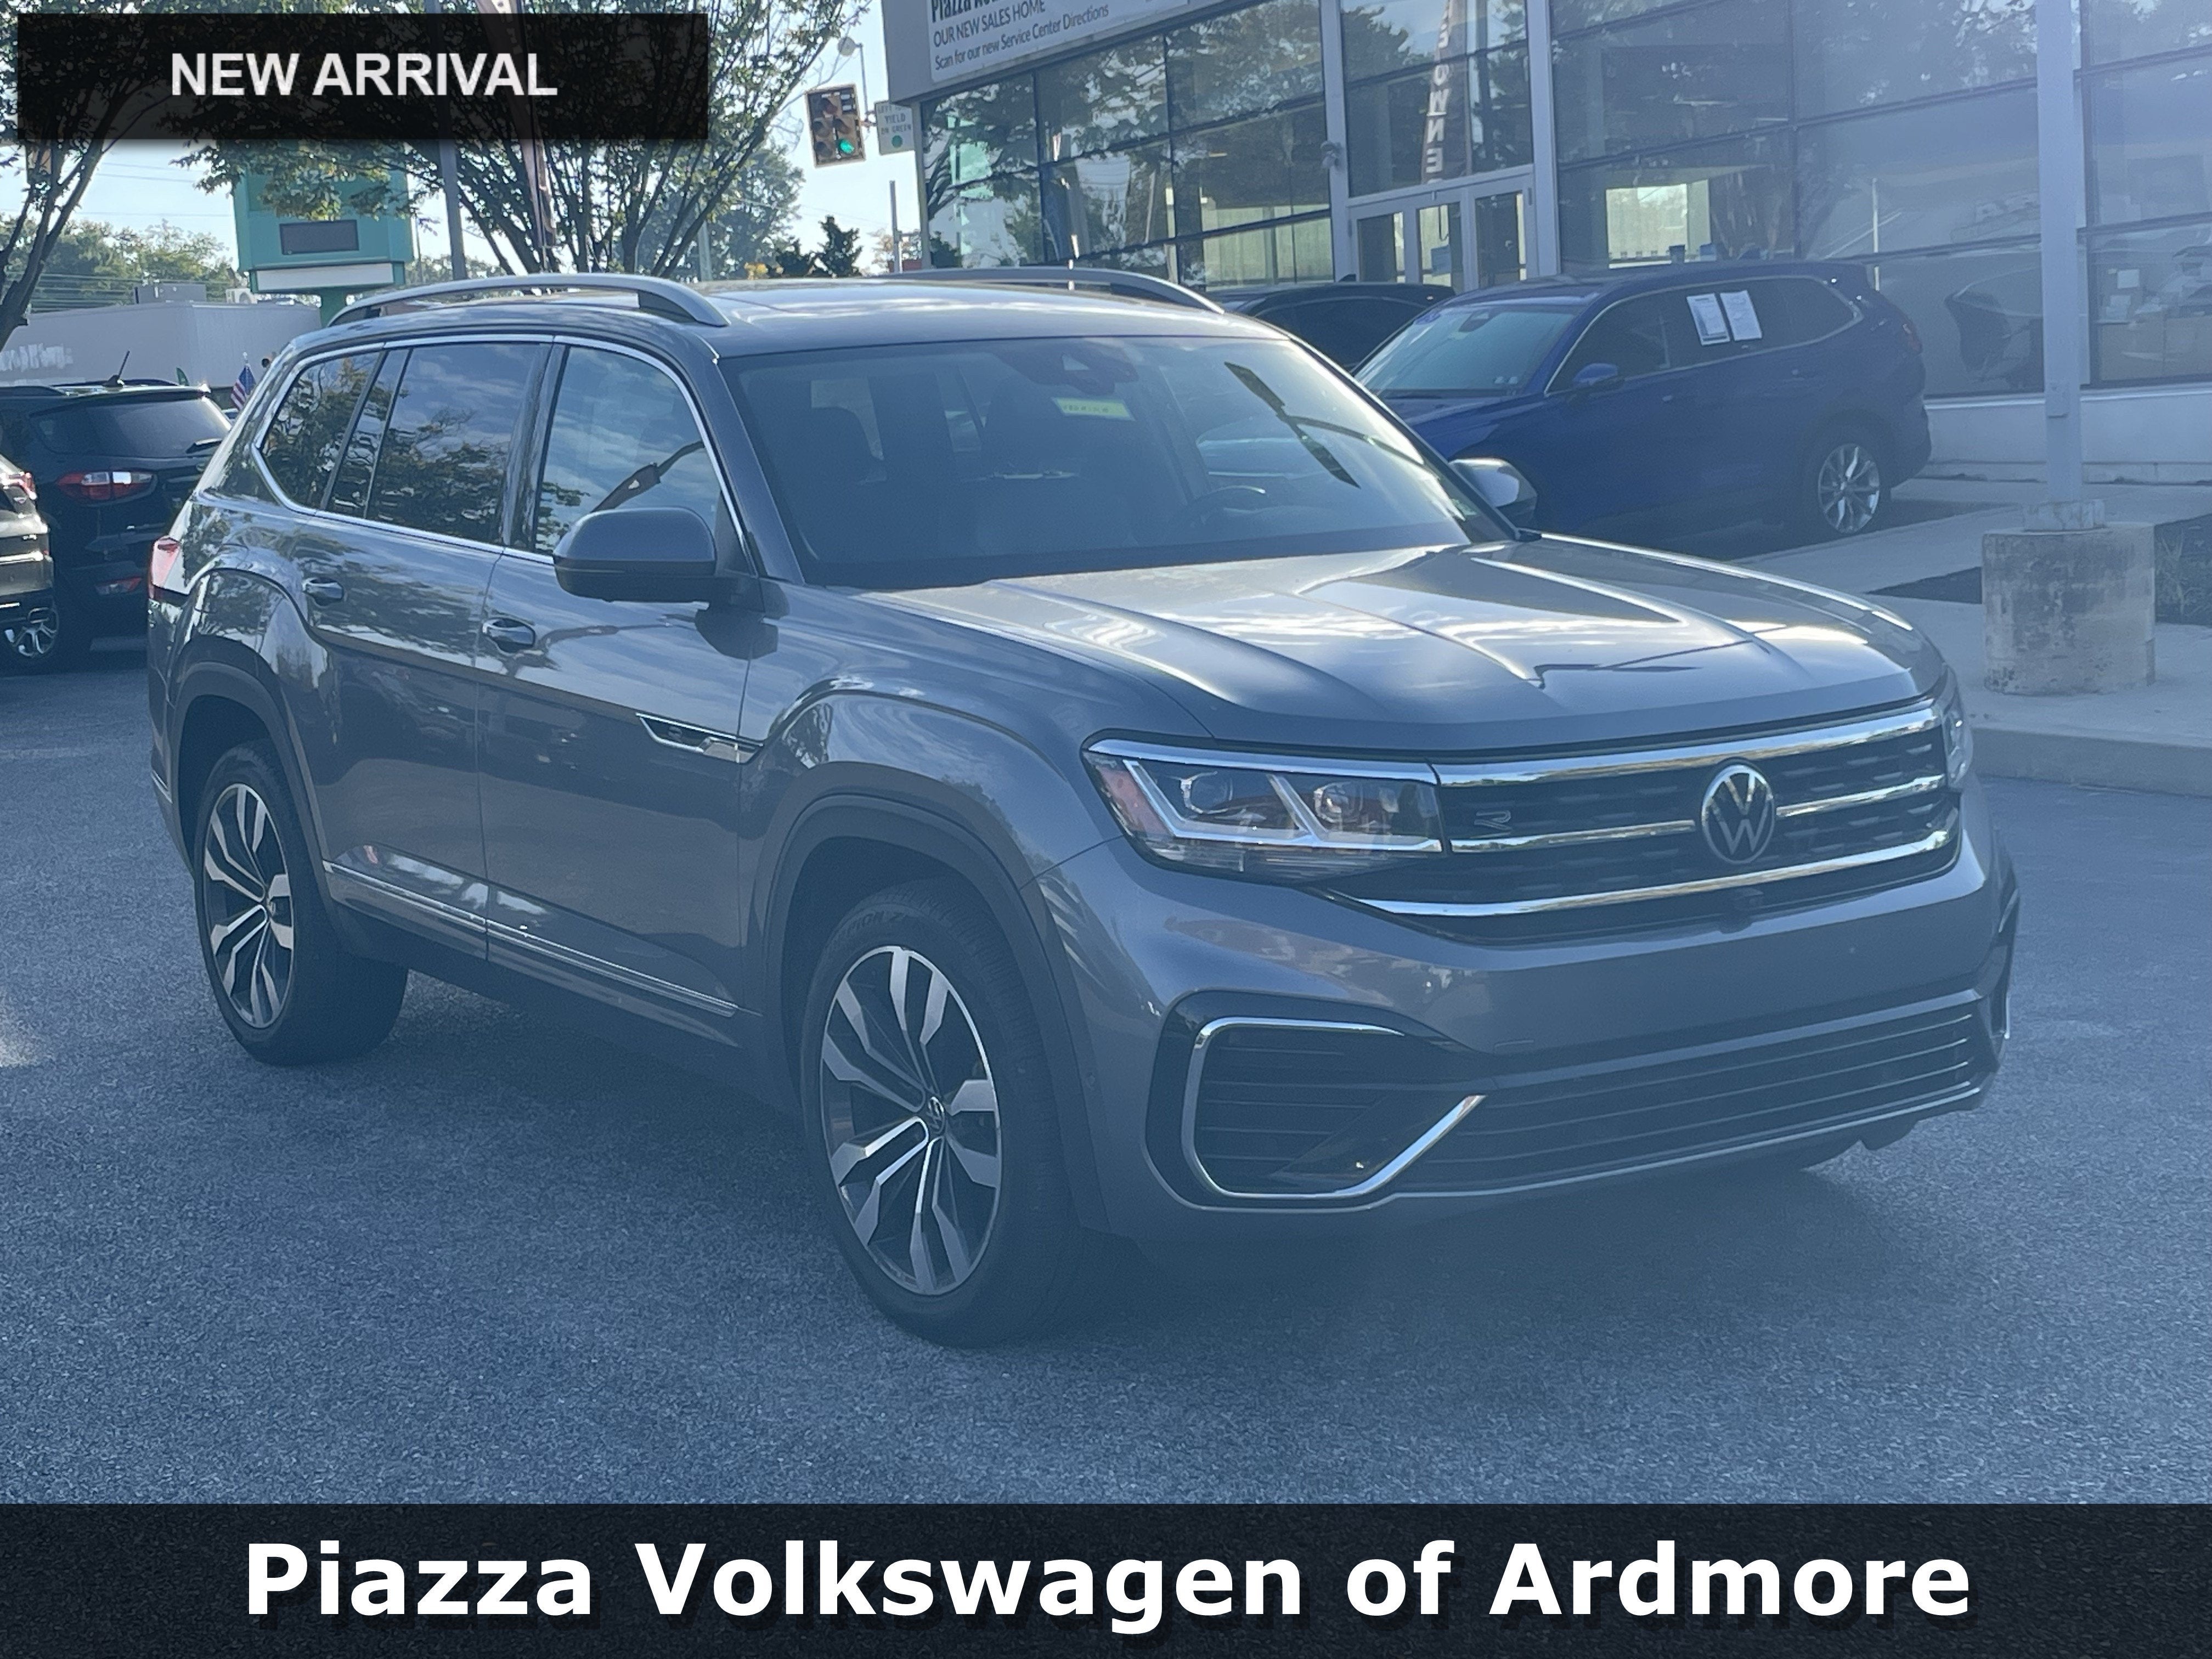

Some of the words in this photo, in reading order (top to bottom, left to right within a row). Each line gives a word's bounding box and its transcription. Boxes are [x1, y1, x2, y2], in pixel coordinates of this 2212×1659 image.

[934, 27, 955, 47] OUR
[956, 17, 979, 41] NEW
[982, 7, 1011, 32] SALES
[1013, 0, 1045, 21] HOME
[935, 55, 953, 71] Scan
[955, 49, 967, 65] for
[967, 46, 981, 60] our
[982, 41, 1000, 55] new
[1001, 29, 1031, 50] Service
[1032, 19, 1061, 40] Center
[1063, 4, 1109, 30] Directions
[884, 113, 906, 123] YIELD
